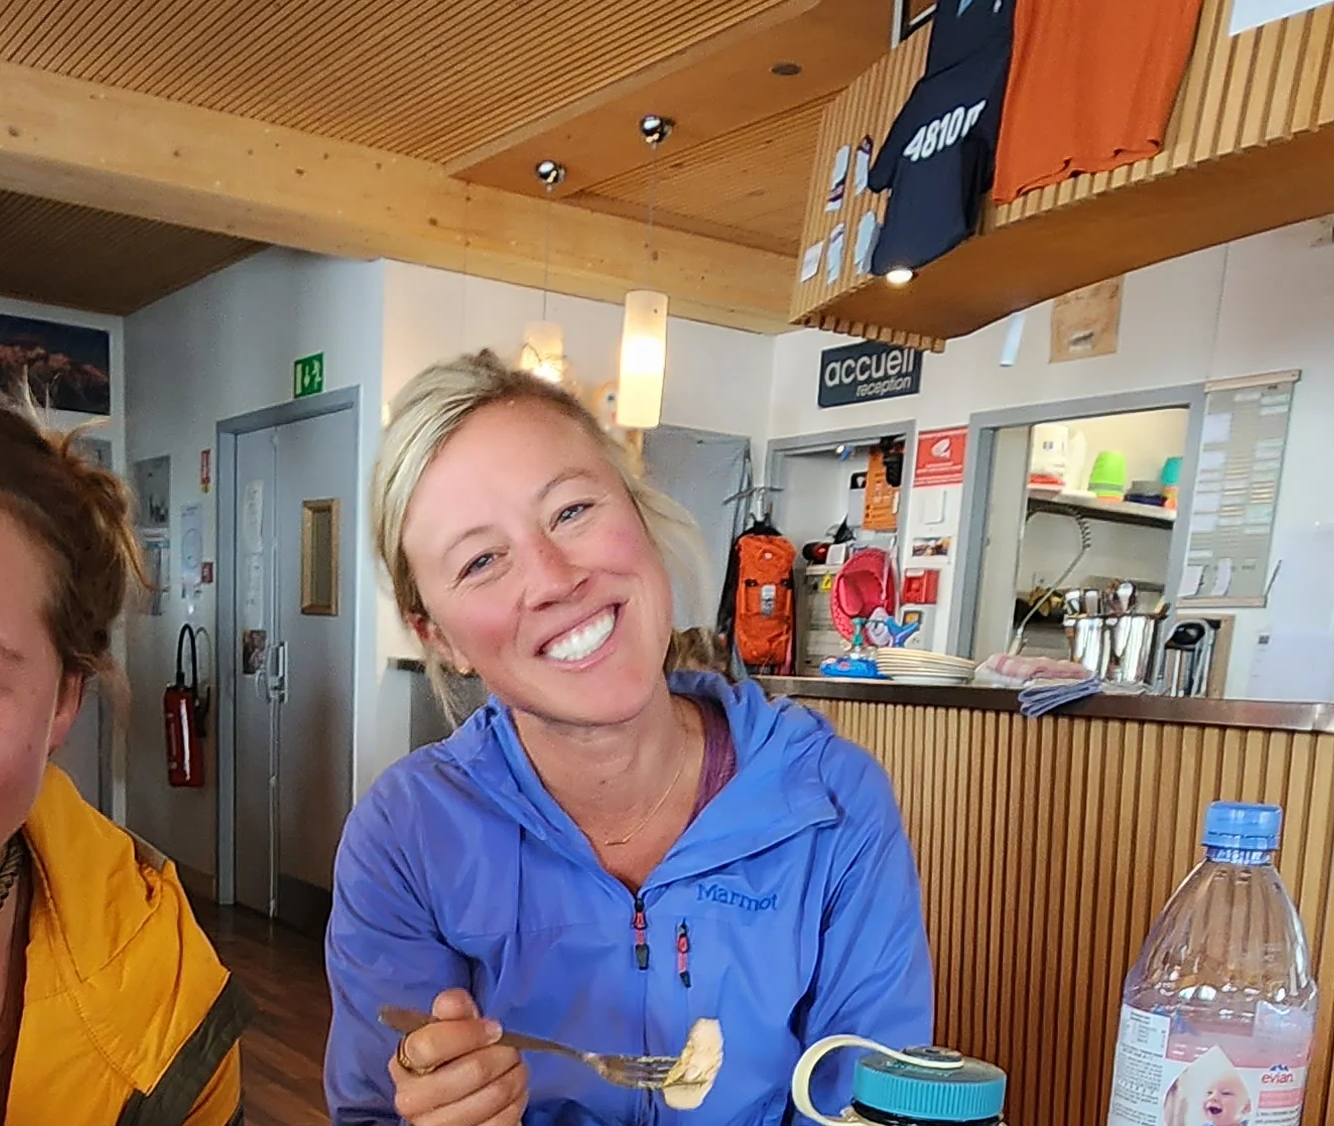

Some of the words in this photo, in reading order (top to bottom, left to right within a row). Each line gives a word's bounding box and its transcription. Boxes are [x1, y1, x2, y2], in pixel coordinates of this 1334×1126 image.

[825, 348, 916, 388] accueil
[856, 376, 912, 398] reception
[696, 883, 780, 912] Marmot
[1261, 1073, 1294, 1085] evian
